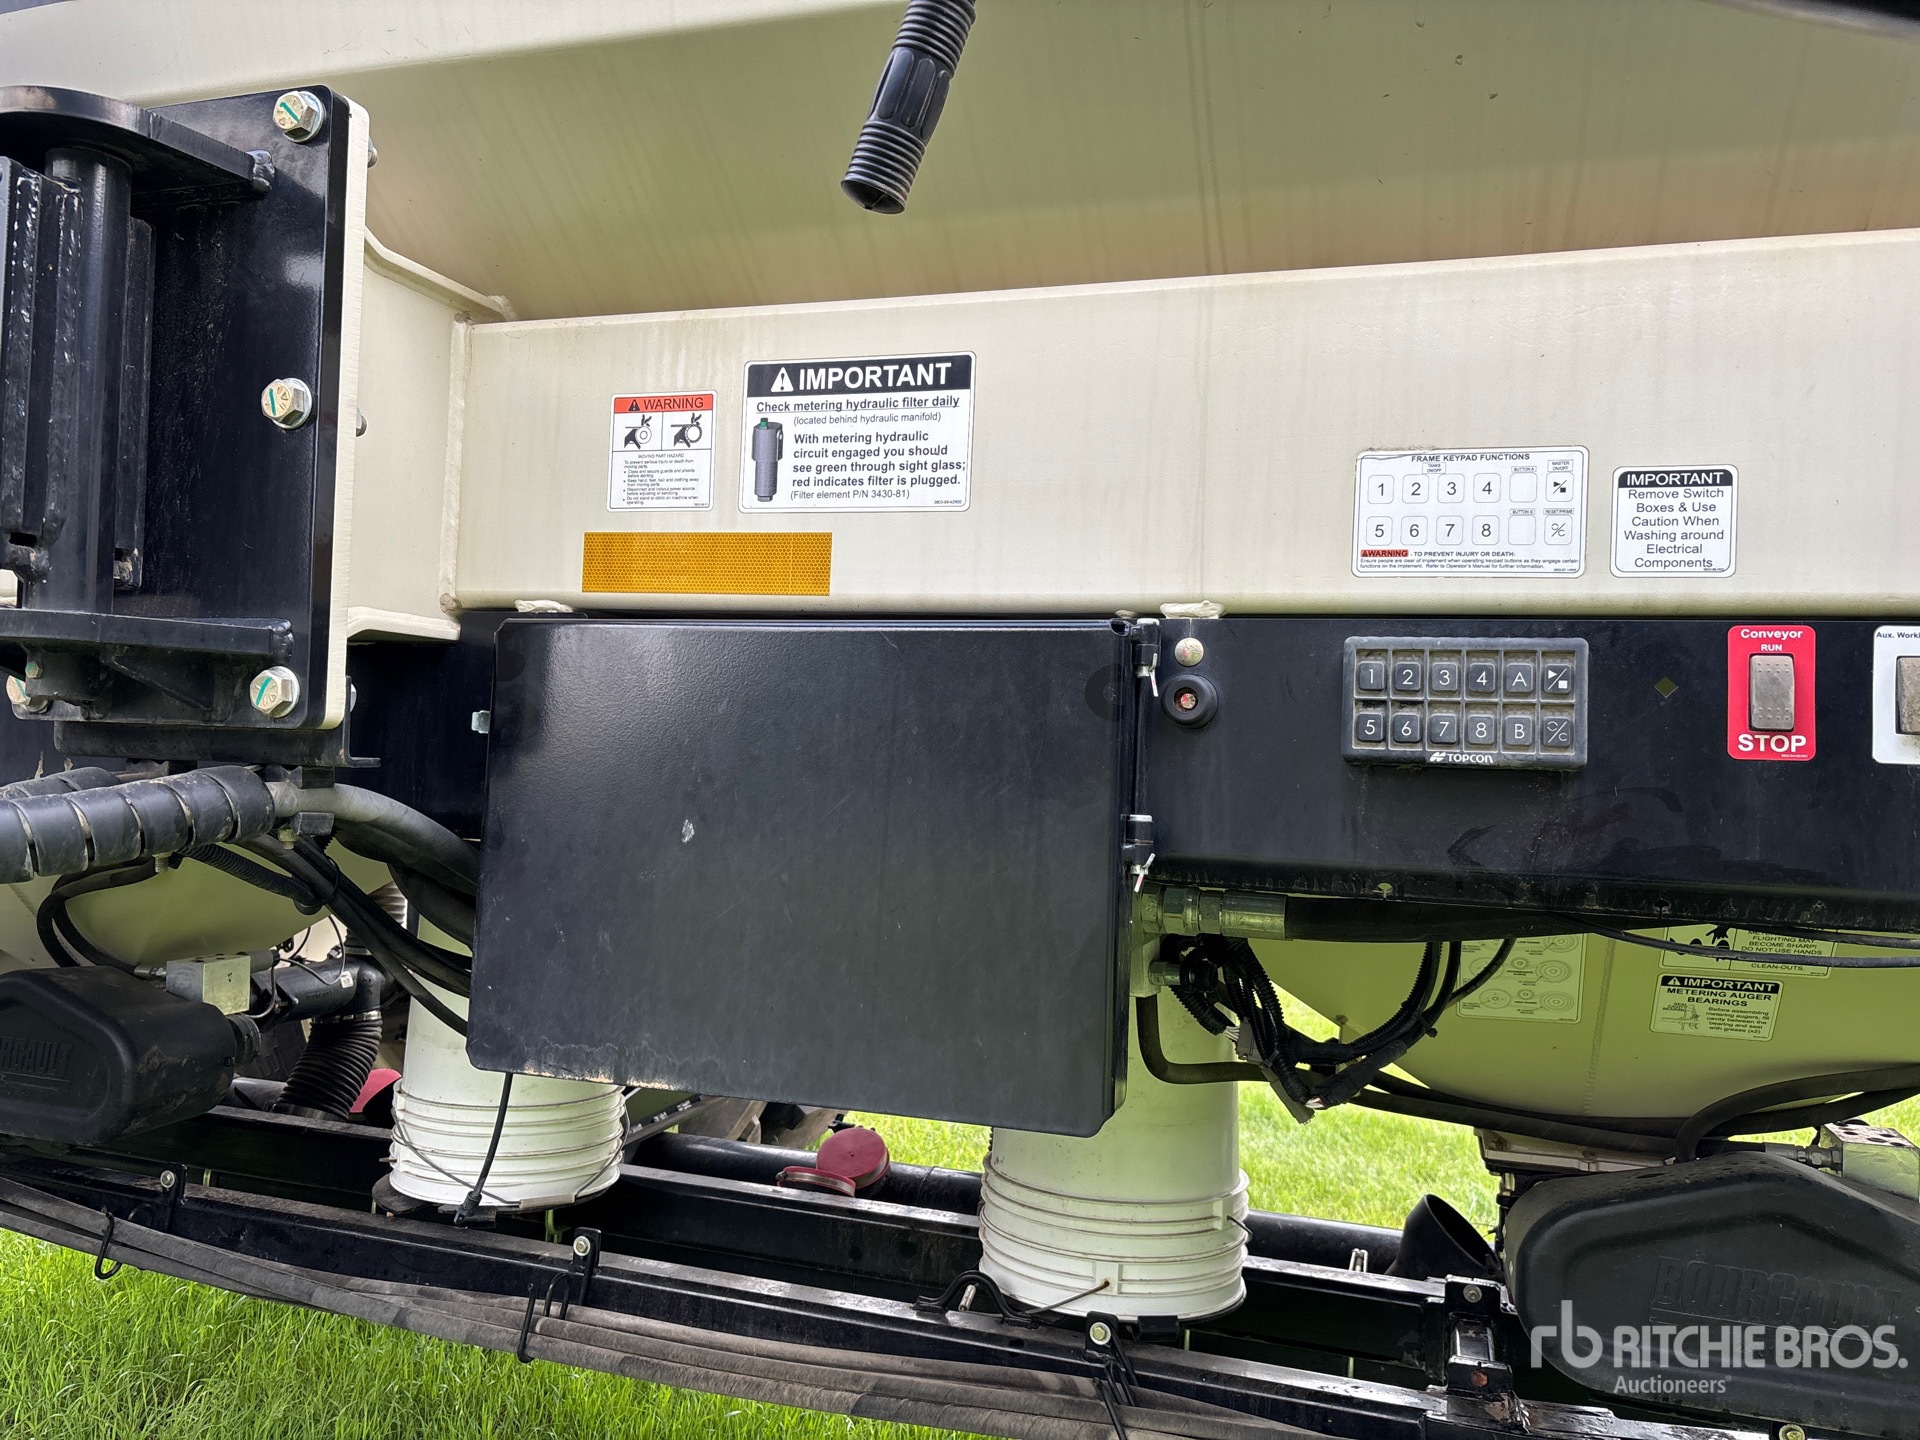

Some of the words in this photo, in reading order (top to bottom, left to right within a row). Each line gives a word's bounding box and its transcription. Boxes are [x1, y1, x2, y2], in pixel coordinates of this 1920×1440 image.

[800, 363, 952, 391] IMPORTANT
[644, 397, 704, 411] WARNING
[757, 401, 790, 412] Check
[794, 400, 843, 413] metering
[846, 398, 899, 412] hydraulic
[902, 397, 930, 409] filter
[932, 395, 960, 409] daily
[794, 416, 827, 427] (located
[829, 415, 858, 424] behind
[860, 413, 899, 425] hydraulic
[901, 412, 942, 423] manifold)
[794, 434, 819, 444] With
[822, 433, 872, 445] metering
[876, 431, 929, 445] hydraulic
[794, 448, 829, 459] circuit
[832, 447, 880, 460] engaged
[884, 448, 905, 459] you
[908, 445, 948, 456] should
[1411, 455, 1441, 463] FRAME
[1480, 453, 1530, 461] FUNCTIONS
[793, 465, 812, 473] see
[816, 464, 847, 474] green
[851, 462, 896, 473] through
[899, 461, 928, 473] sight
[931, 461, 968, 473] glass;
[792, 478, 810, 487] red
[814, 477, 864, 487] indicates
[868, 476, 894, 486] filter
[897, 476, 907, 486] is
[911, 474, 961, 488] plugged.
[1627, 472, 1724, 486] IMPORTANT
[790, 491, 815, 501] (Filter
[816, 491, 850, 499] element
[853, 490, 869, 498] P/N
[871, 489, 910, 500] 3430-81)
[1378, 483, 1384, 496] 1
[1411, 482, 1421, 496] 2
[1447, 482, 1457, 496] 3
[1482, 481, 1492, 495] 4
[1628, 490, 1679, 499] Remove
[1683, 488, 1724, 499] Switch
[1636, 503, 1675, 513] Boxes
[1678, 503, 1688, 513] &
[1692, 502, 1717, 513] Use
[1632, 517, 1679, 527] Caution
[1683, 516, 1720, 526] When
[1375, 524, 1384, 538] 5
[1410, 524, 1420, 538] 6
[1446, 524, 1455, 538] 7
[1481, 523, 1492, 538] 8
[1624, 530, 1677, 542] Washing
[1681, 530, 1724, 540] around
[1647, 544, 1703, 554] Electrical
[1634, 558, 1713, 570] Components
[1741, 629, 1803, 641] Conveyor
[1897, 631, 1920, 640] Worki
[1761, 644, 1782, 652] RUN
[1369, 669, 1374, 684] 1
[1403, 669, 1413, 685] 2
[1439, 670, 1450, 686] 3
[1477, 671, 1487, 686] 4
[1512, 672, 1527, 687] A
[1365, 720, 1376, 735] 5
[1401, 721, 1412, 736] 6
[1440, 722, 1450, 737] 7
[1476, 722, 1487, 738] 8
[1515, 724, 1525, 739] B
[1738, 734, 1807, 753] STOP
[1684, 978, 1775, 992] IMPORTANT
[1667, 988, 1727, 998] METERING
[1729, 992, 1772, 1001] AUGER
[1687, 997, 1748, 1007] BEARINGS
